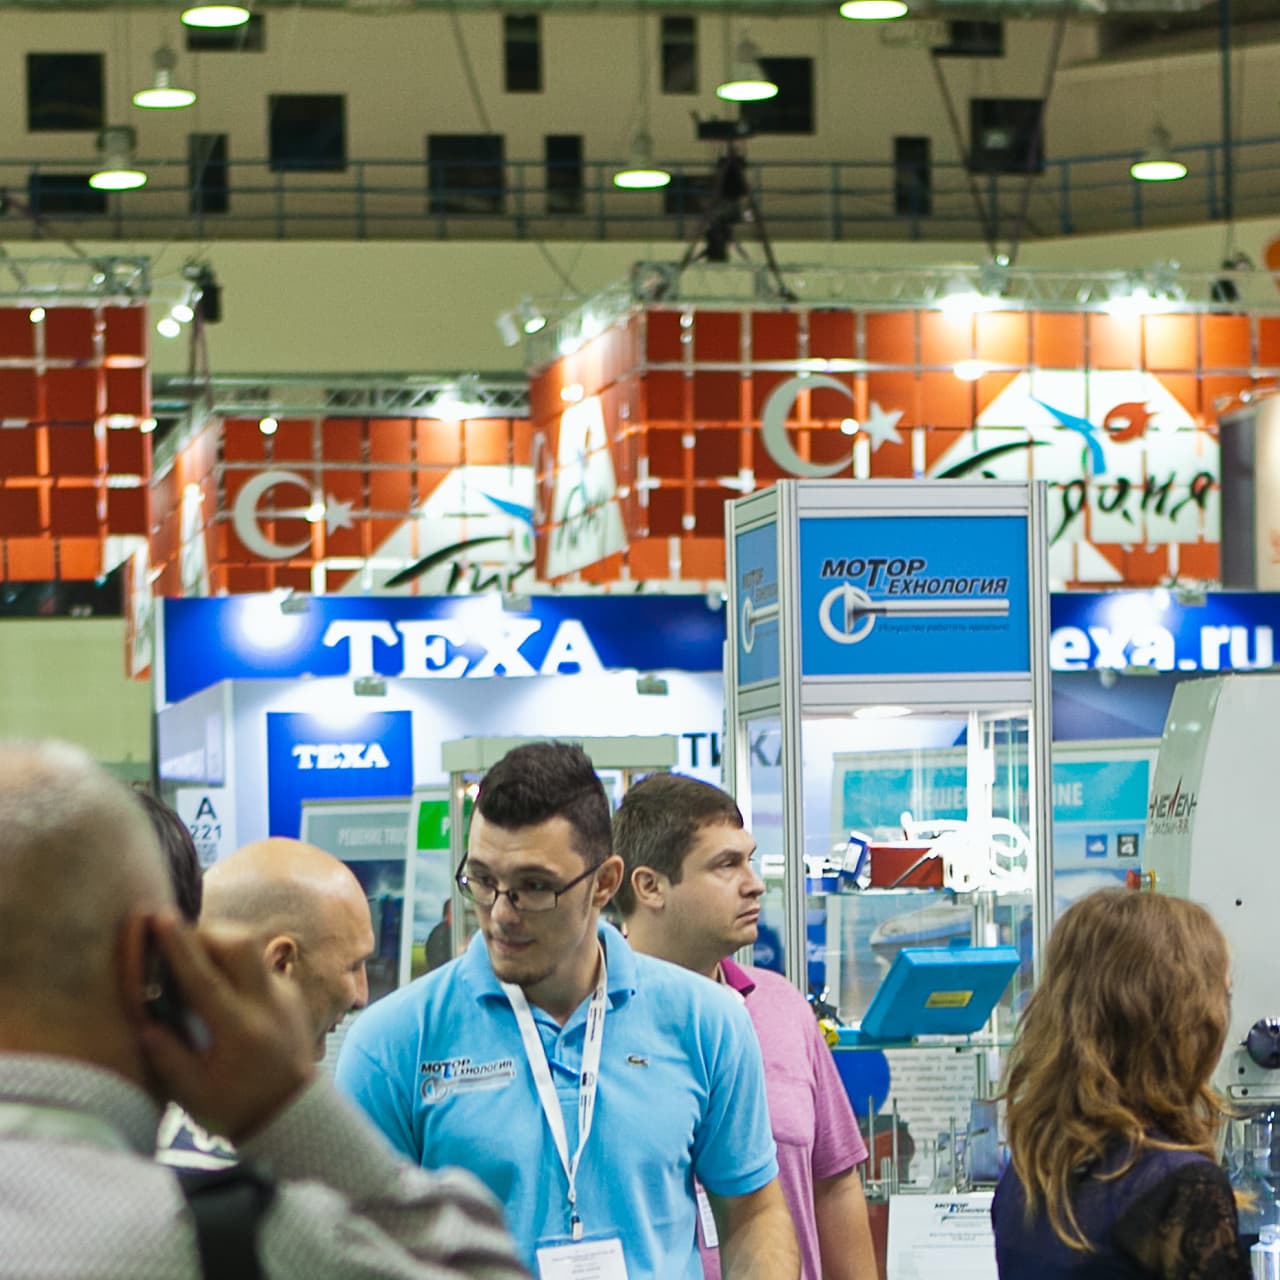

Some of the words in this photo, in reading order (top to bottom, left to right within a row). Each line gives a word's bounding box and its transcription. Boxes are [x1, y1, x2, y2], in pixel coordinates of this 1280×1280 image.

[821, 559, 926, 588] МОТОР
[322, 619, 606, 679] TEXA
[1049, 625, 1274, 672] exa.ru
[291, 742, 390, 770] TEXA
[195, 796, 218, 821] A
[191, 824, 222, 841] 221
